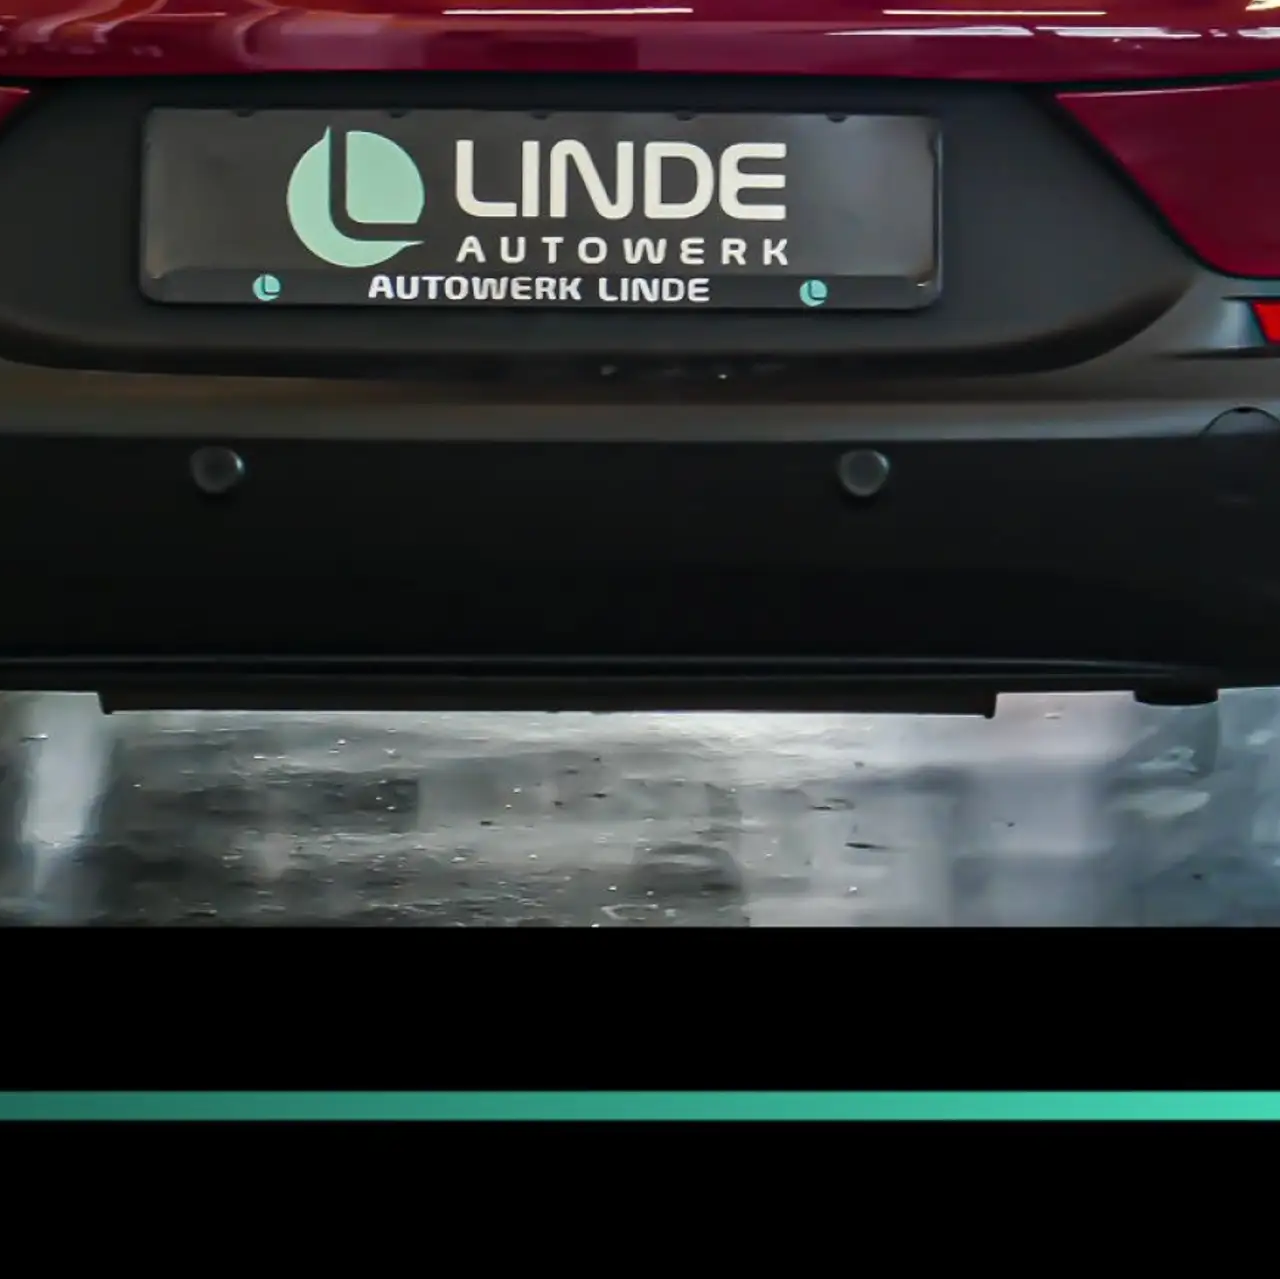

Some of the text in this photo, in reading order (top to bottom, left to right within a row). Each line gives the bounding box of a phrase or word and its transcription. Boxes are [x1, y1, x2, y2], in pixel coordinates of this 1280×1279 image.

[457, 140, 786, 220] LINDE
[457, 236, 788, 265] AUTOWERK
[367, 273, 711, 304] AUTOWERK LINDE
